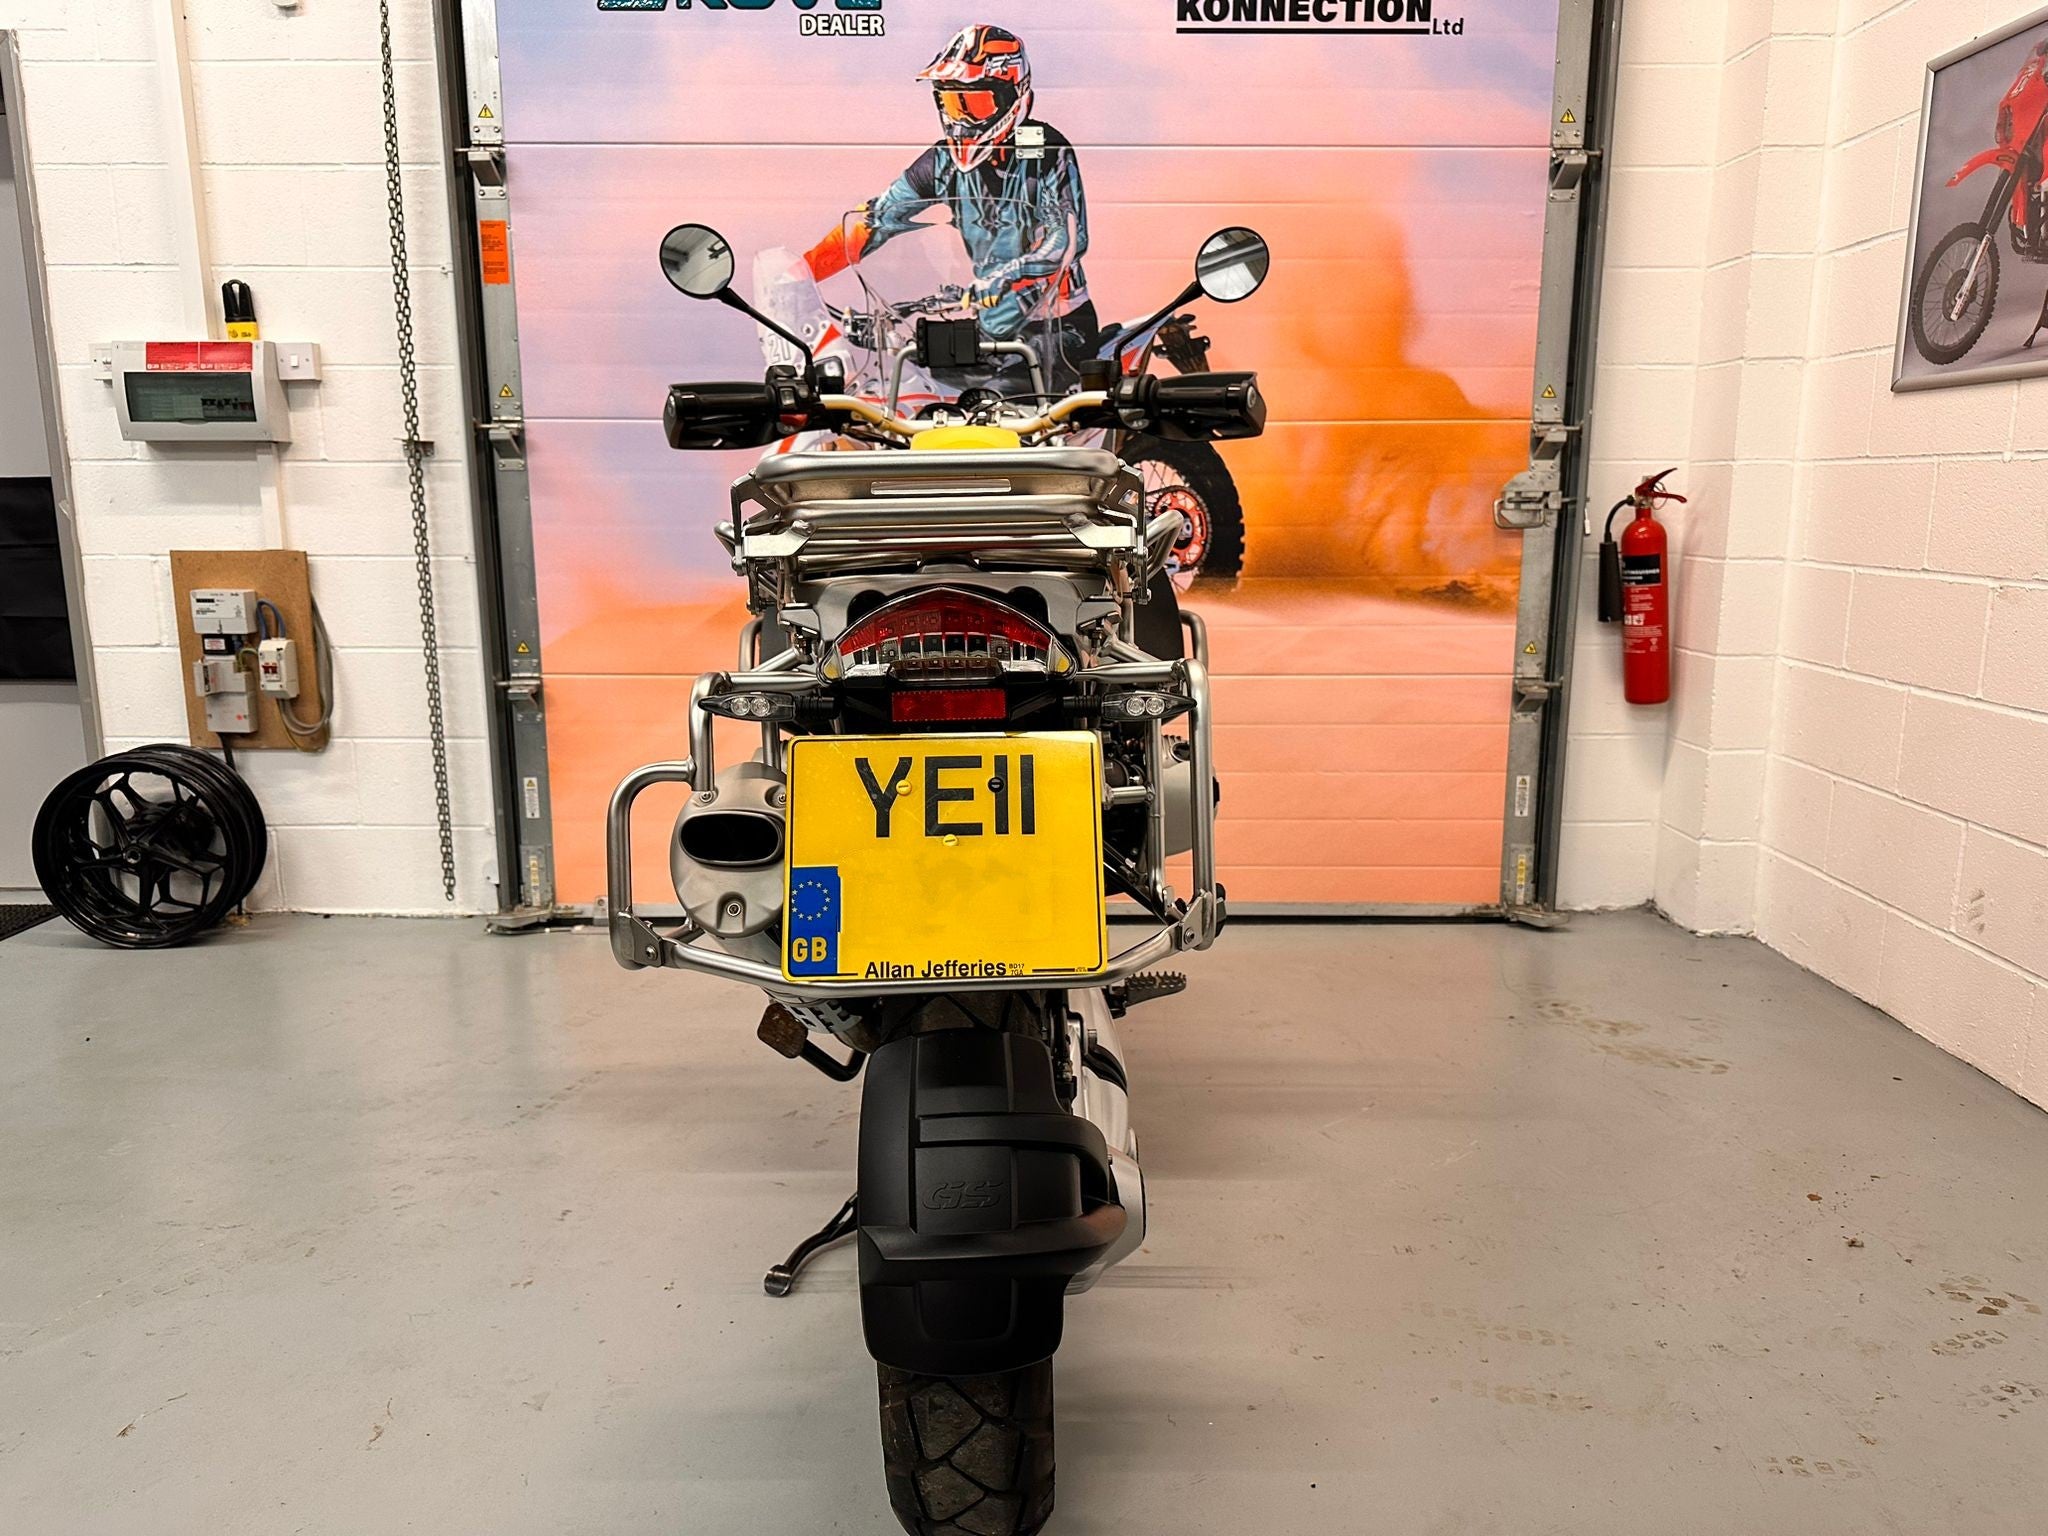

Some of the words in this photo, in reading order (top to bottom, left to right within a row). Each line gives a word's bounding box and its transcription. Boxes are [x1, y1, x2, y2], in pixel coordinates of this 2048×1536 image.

[1177, 0, 1431, 22] KONNECTION
[800, 14, 884, 36] DEALER
[1432, 17, 1464, 35] Ltd
[855, 754, 1036, 838] YE11
[792, 936, 828, 963] GB
[865, 961, 915, 979] Allan
[921, 959, 1007, 978] Jefferies
